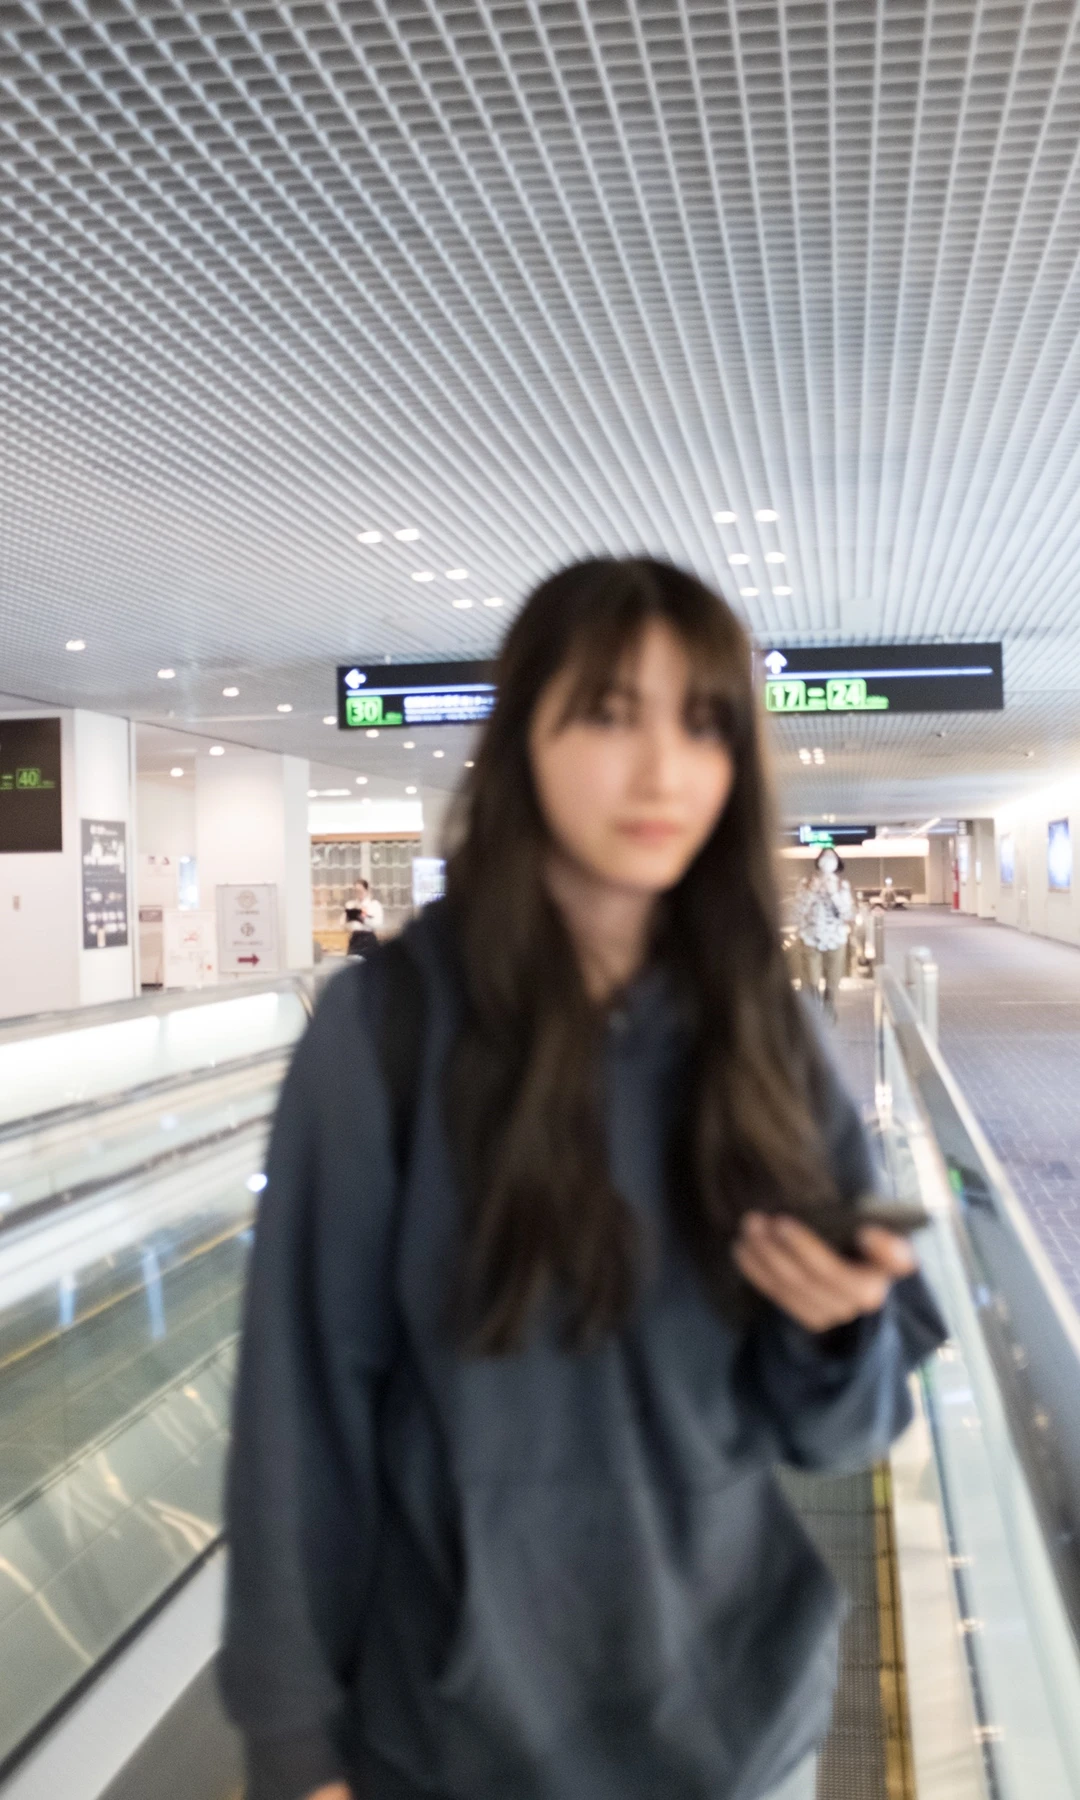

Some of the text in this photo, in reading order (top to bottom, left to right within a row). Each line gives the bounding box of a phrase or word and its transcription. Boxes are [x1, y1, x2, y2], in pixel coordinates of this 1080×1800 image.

[772, 686, 799, 708] 17
[833, 684, 861, 706] 24
[351, 701, 379, 722] 30
[19, 771, 37, 787] 40
